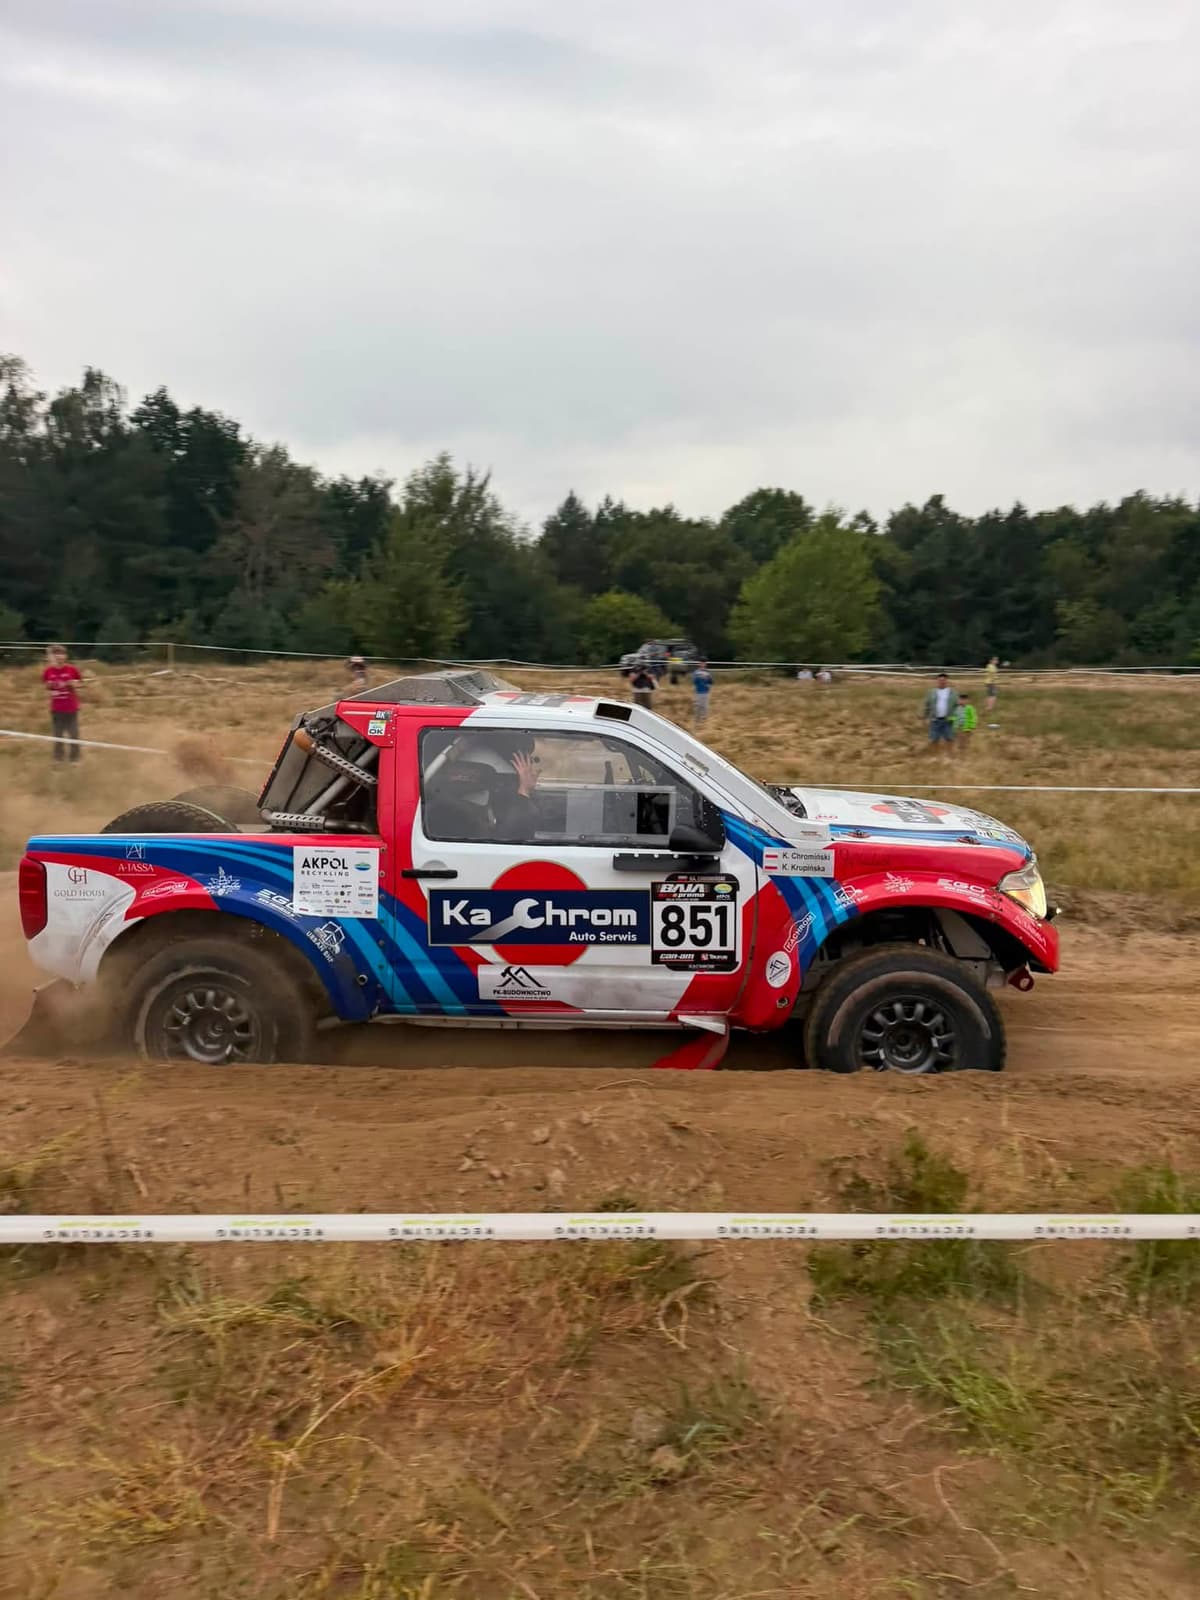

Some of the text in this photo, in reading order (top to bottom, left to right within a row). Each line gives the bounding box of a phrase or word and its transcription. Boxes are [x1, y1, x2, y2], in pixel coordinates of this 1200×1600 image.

[302, 857, 349, 870] AKPOL
[54, 889, 78, 897] GOLD
[659, 883, 705, 893] BAJA
[442, 900, 492, 926] Ka
[660, 905, 728, 947] 851
[569, 931, 638, 942] Auto Serwis
[786, 915, 814, 951] KACHROM
